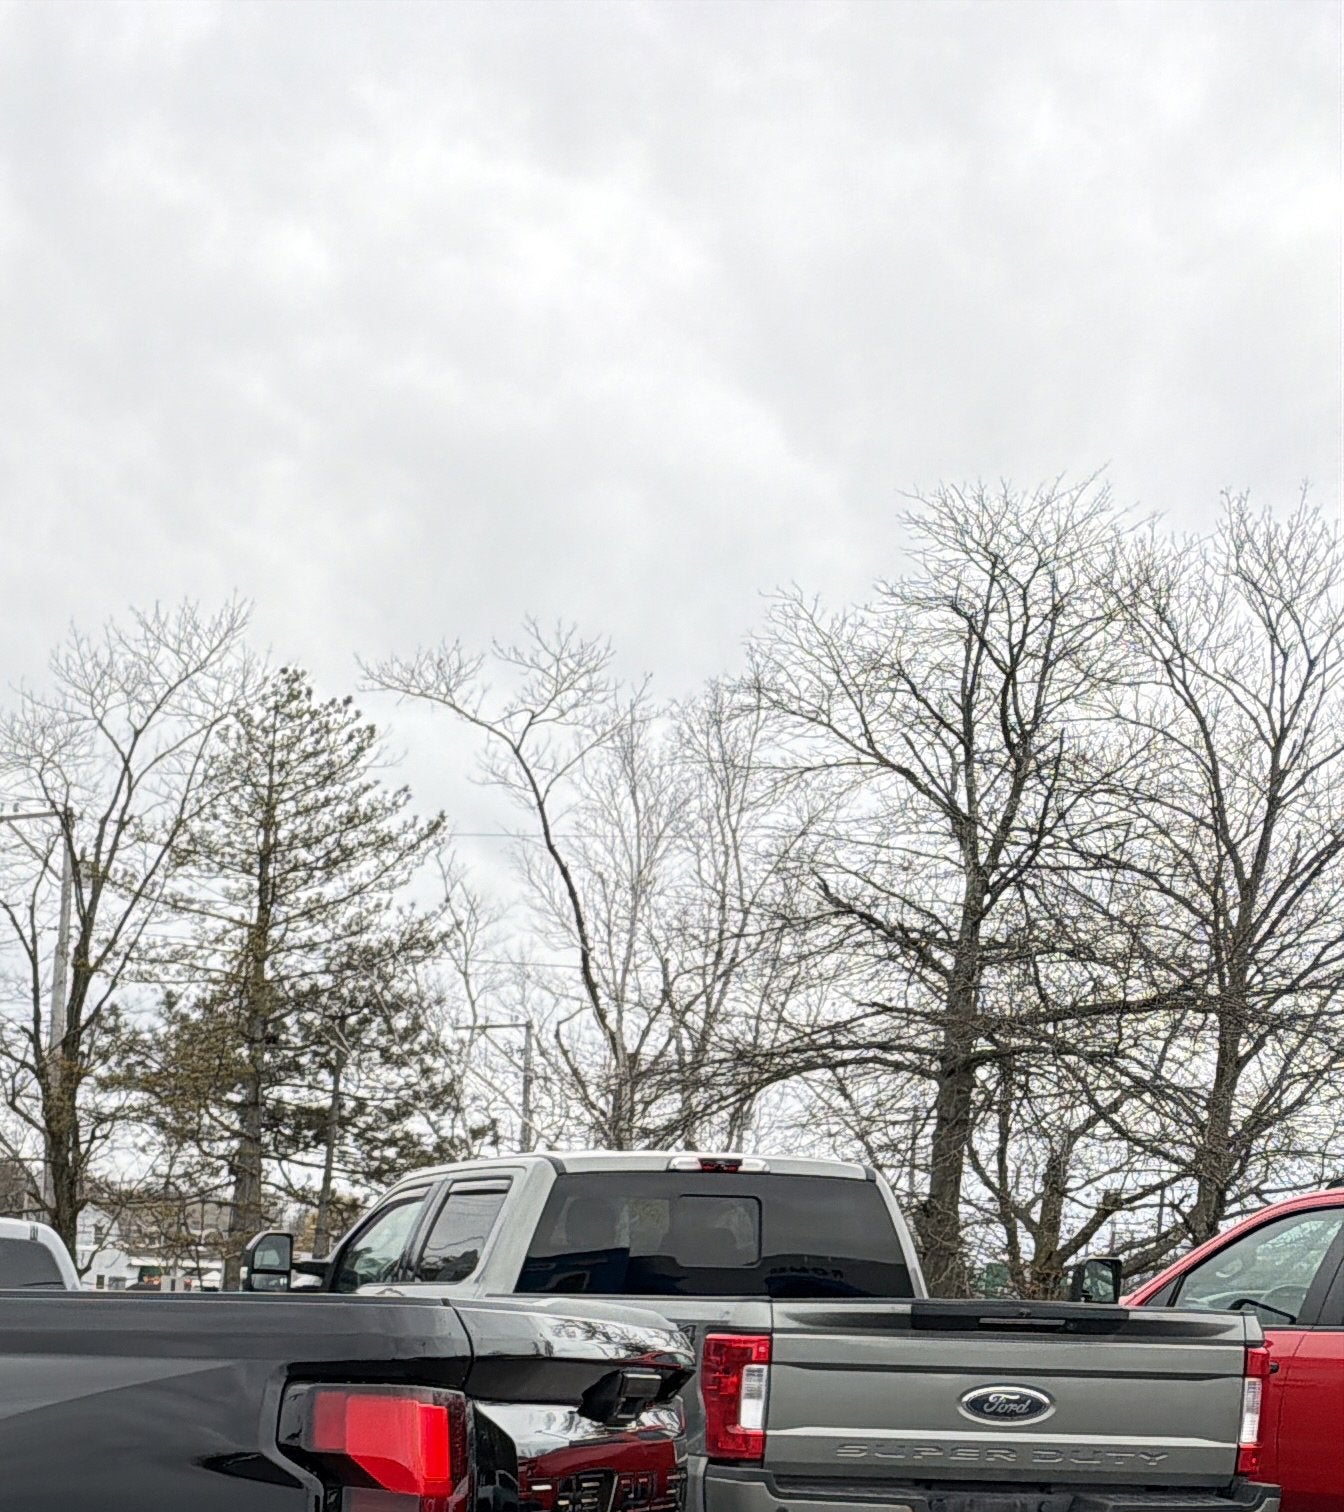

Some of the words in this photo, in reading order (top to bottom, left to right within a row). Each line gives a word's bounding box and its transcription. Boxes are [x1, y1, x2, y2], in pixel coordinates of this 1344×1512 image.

[983, 1393, 1032, 1414] Ford
[836, 1443, 1018, 1462] SUPER
[1031, 1449, 1169, 1467] DUTY
